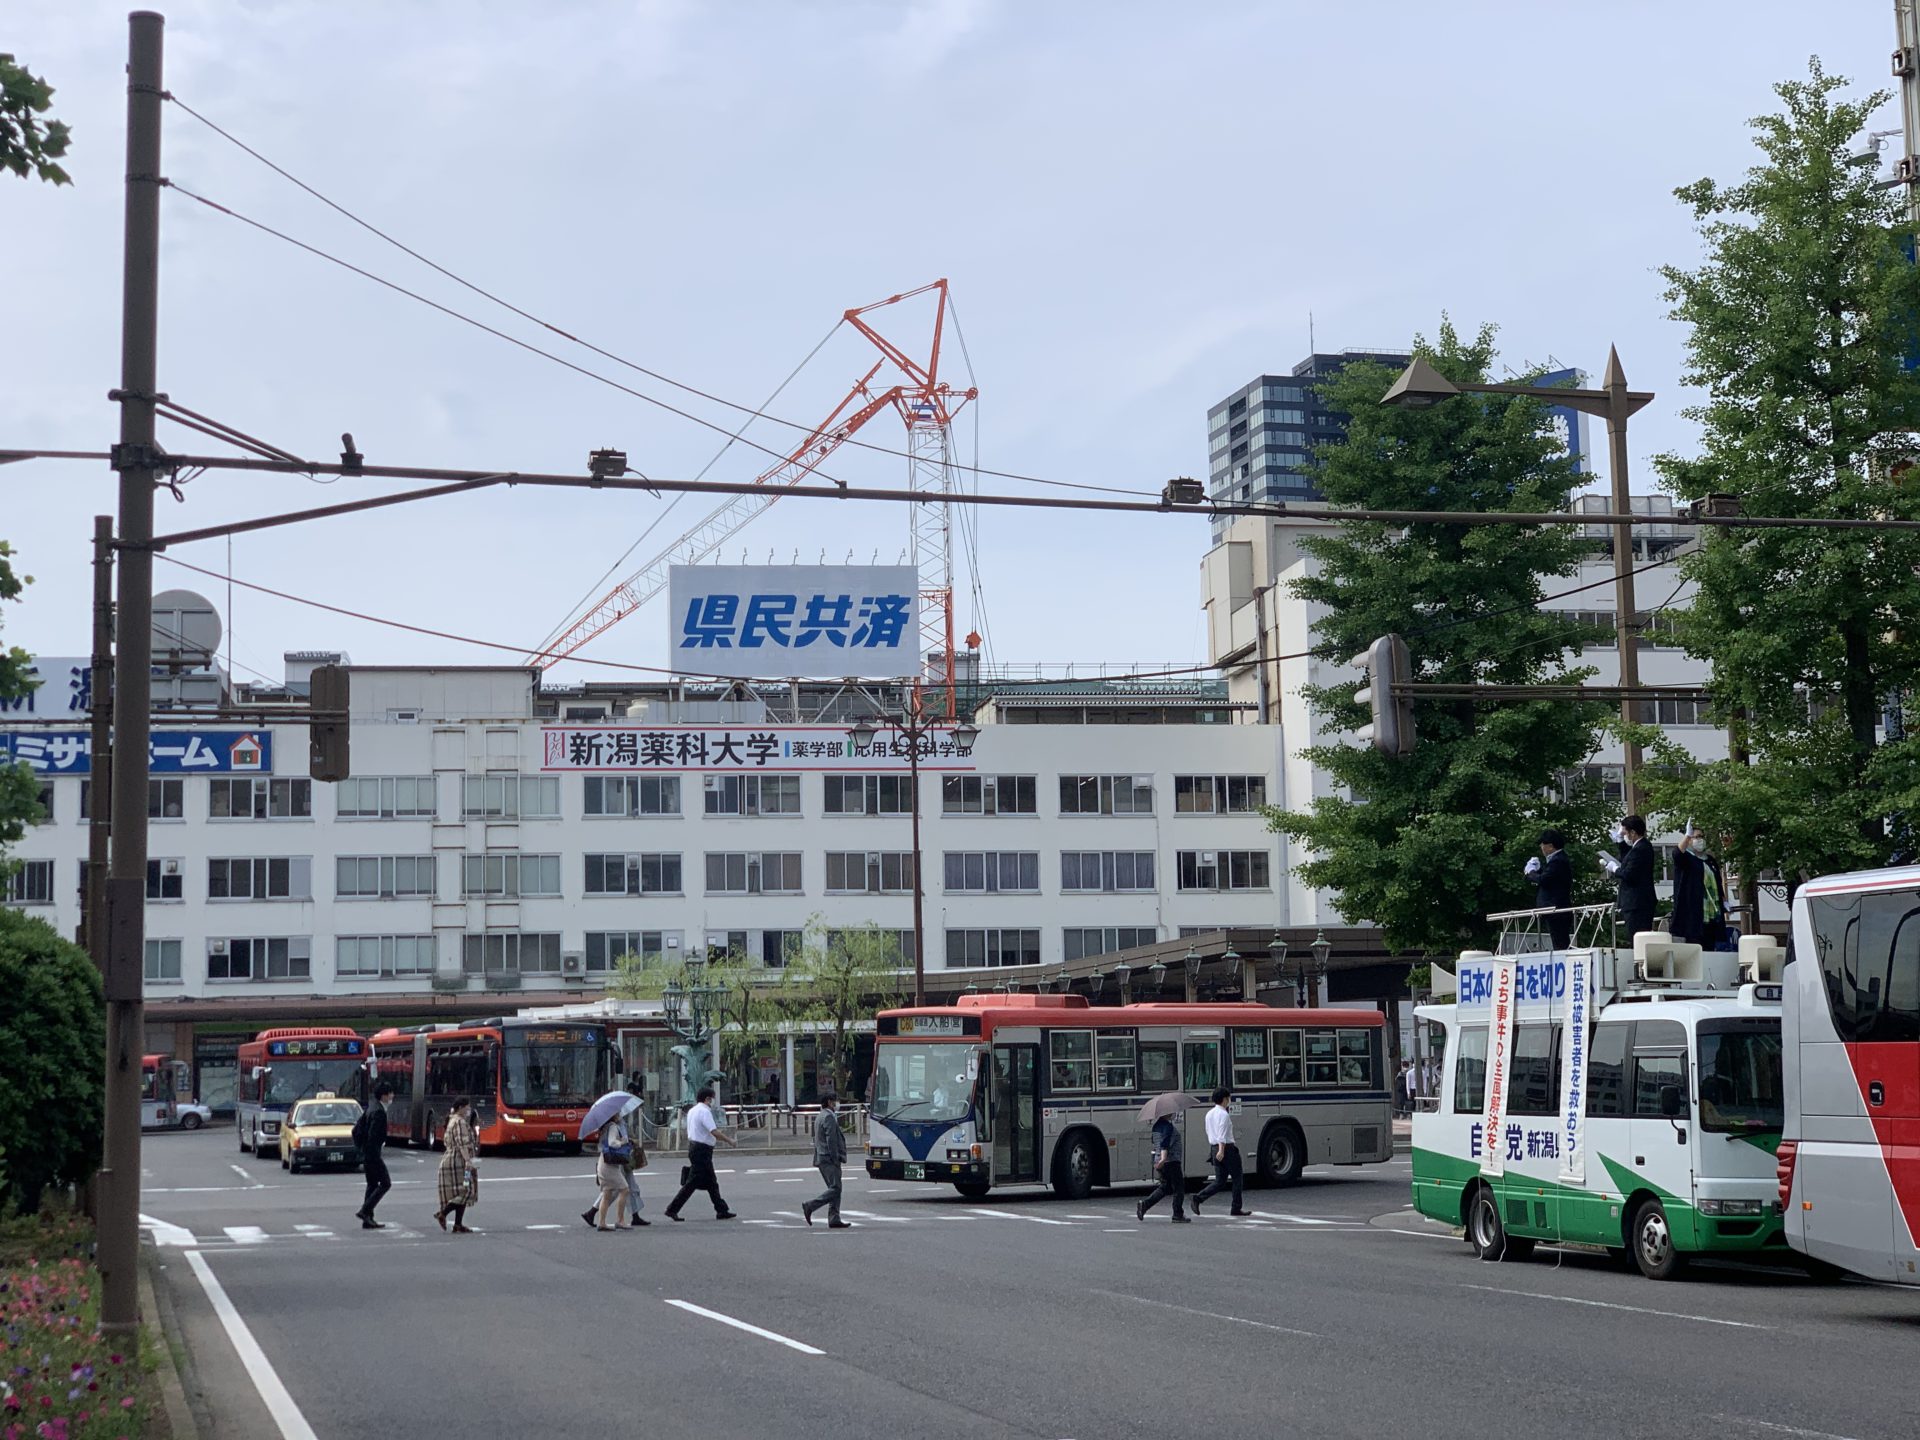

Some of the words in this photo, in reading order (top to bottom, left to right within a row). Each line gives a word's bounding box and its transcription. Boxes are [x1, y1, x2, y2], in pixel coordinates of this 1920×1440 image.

[680, 594, 912, 649] 県民共済
[13, 736, 220, 770] ミサーム
[570, 732, 781, 766] 新潟薬科大学
[792, 741, 843, 758] 薬学部
[854, 741, 973, 758] 応用生科学部
[1471, 1121, 1523, 1161] 自党
[916, 1168, 925, 1179] 29
